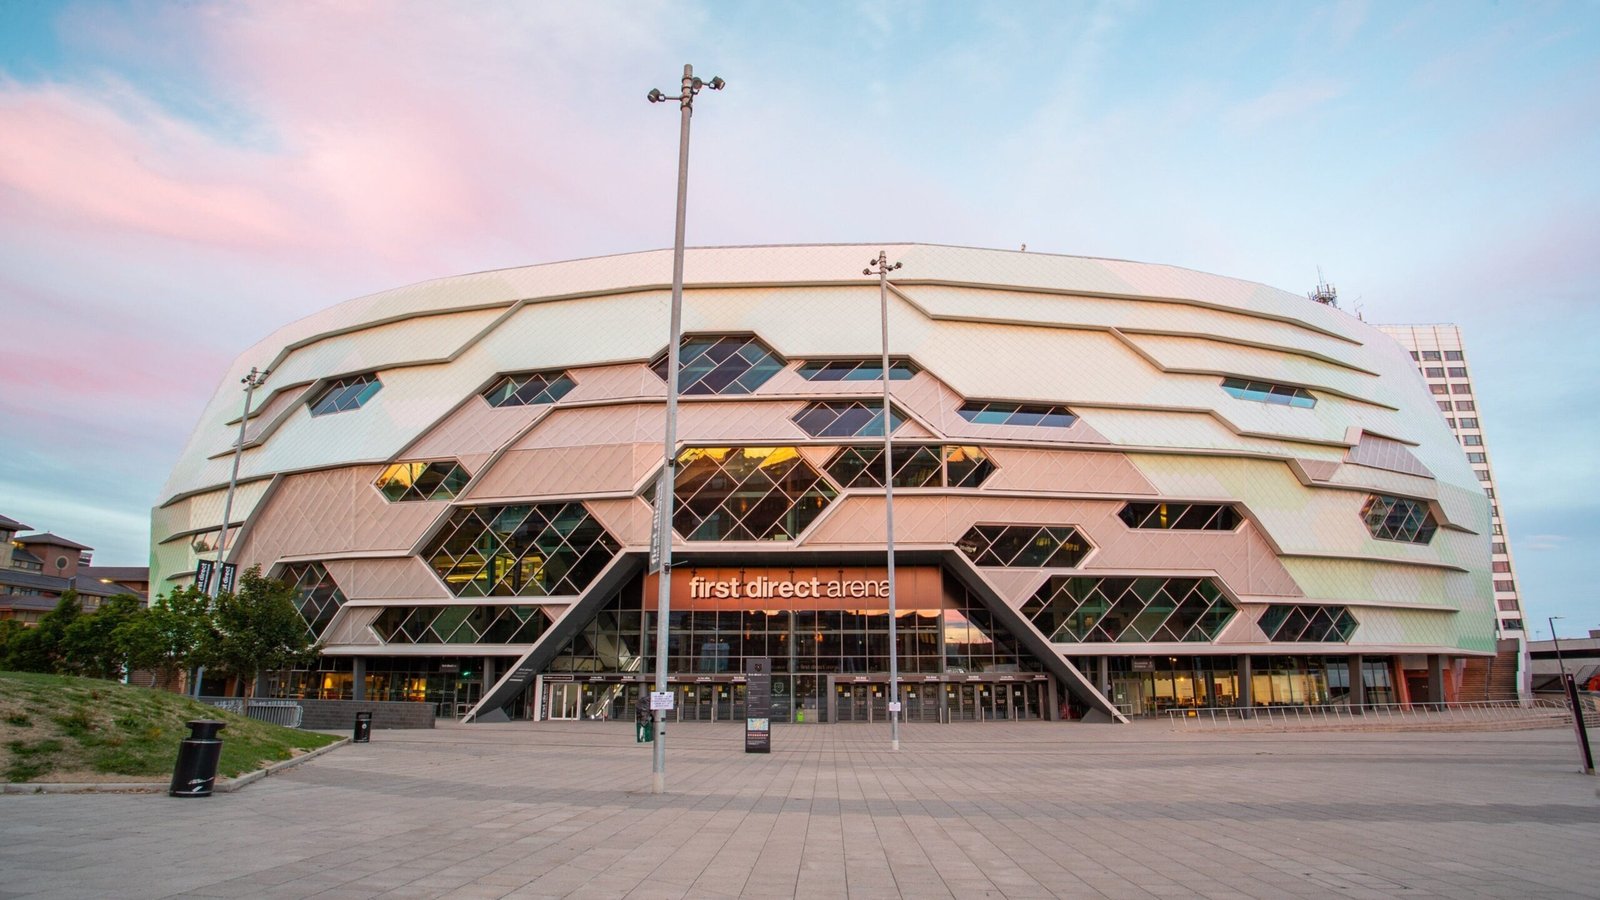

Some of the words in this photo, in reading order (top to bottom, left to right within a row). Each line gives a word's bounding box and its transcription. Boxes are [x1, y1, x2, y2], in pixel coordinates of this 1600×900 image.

[689, 576, 740, 598] first
[746, 576, 820, 598] direct
[827, 579, 889, 598] arena
